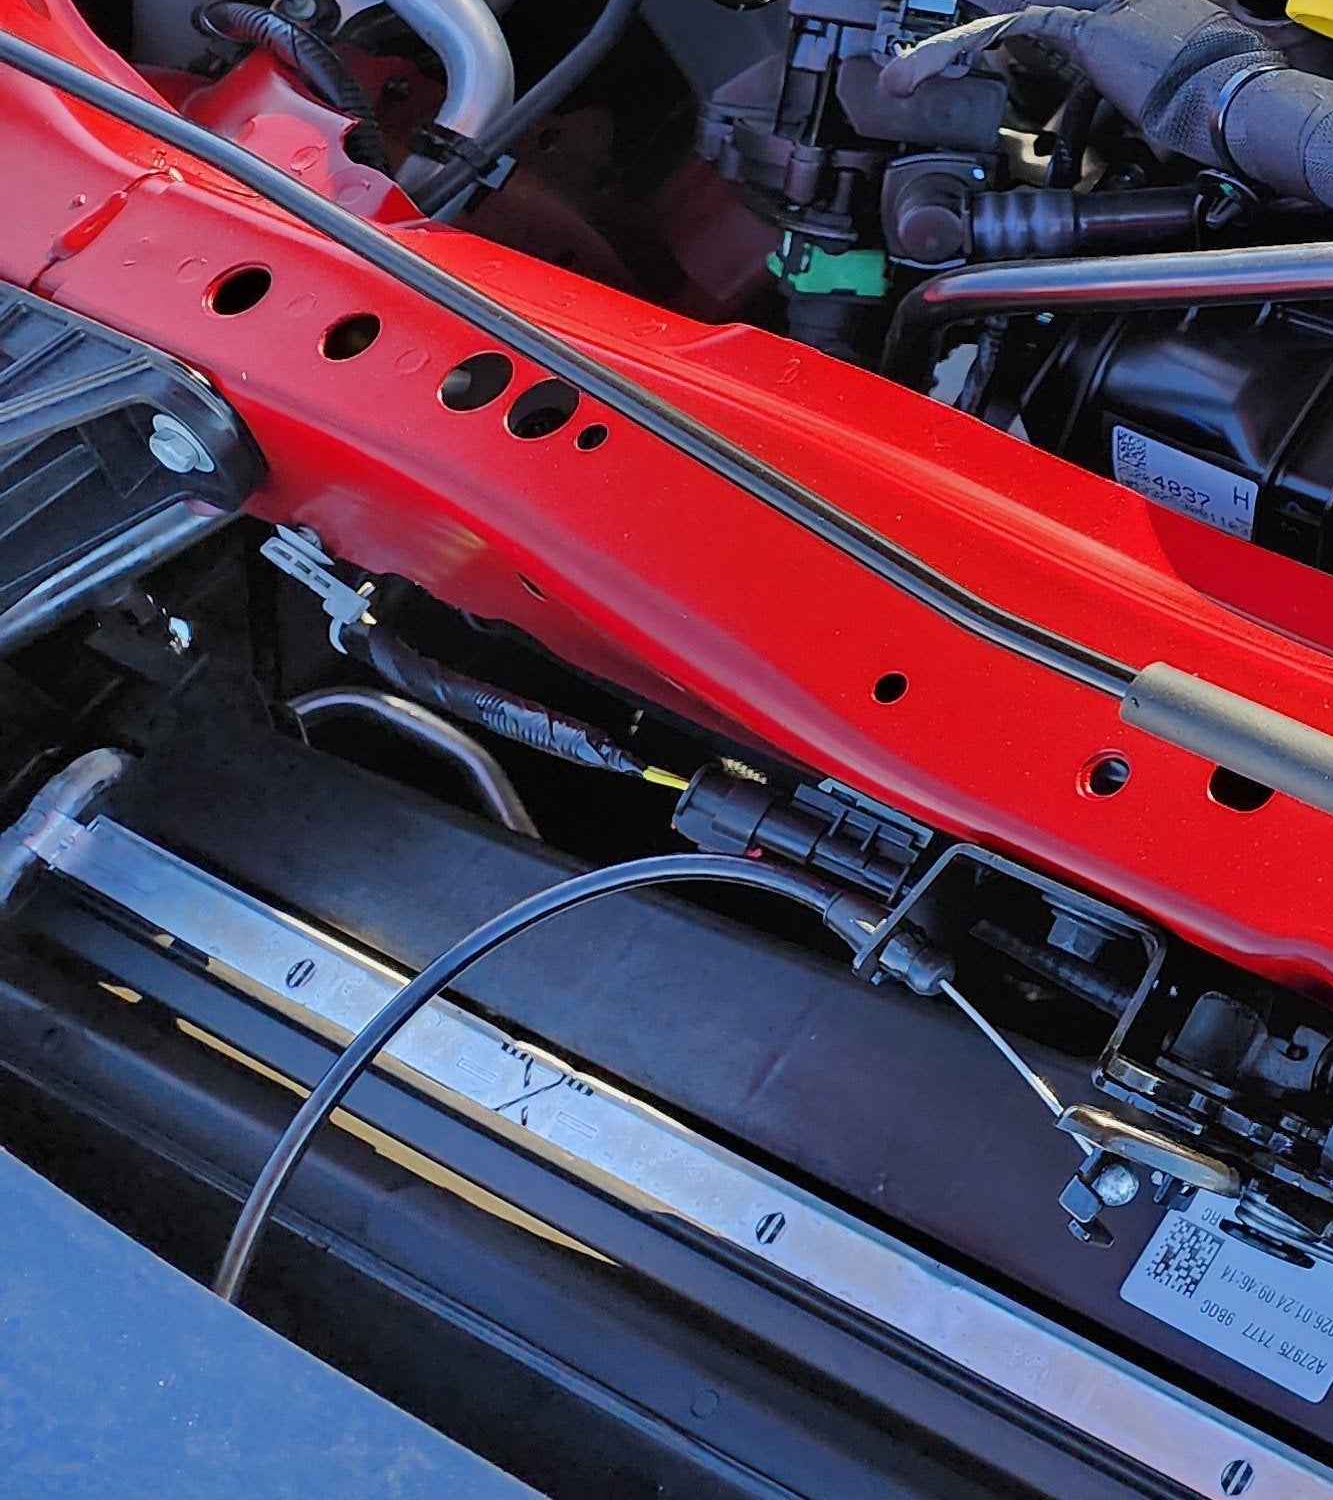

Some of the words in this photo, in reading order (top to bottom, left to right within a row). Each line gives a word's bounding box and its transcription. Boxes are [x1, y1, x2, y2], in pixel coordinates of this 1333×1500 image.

[1152, 475, 1211, 508] 4837
[1232, 485, 1251, 511] H
[1219, 1264, 1277, 1308] 09:46:14
[1241, 1323, 1275, 1349] 7177
[1279, 1339, 1329, 1376] A27975
